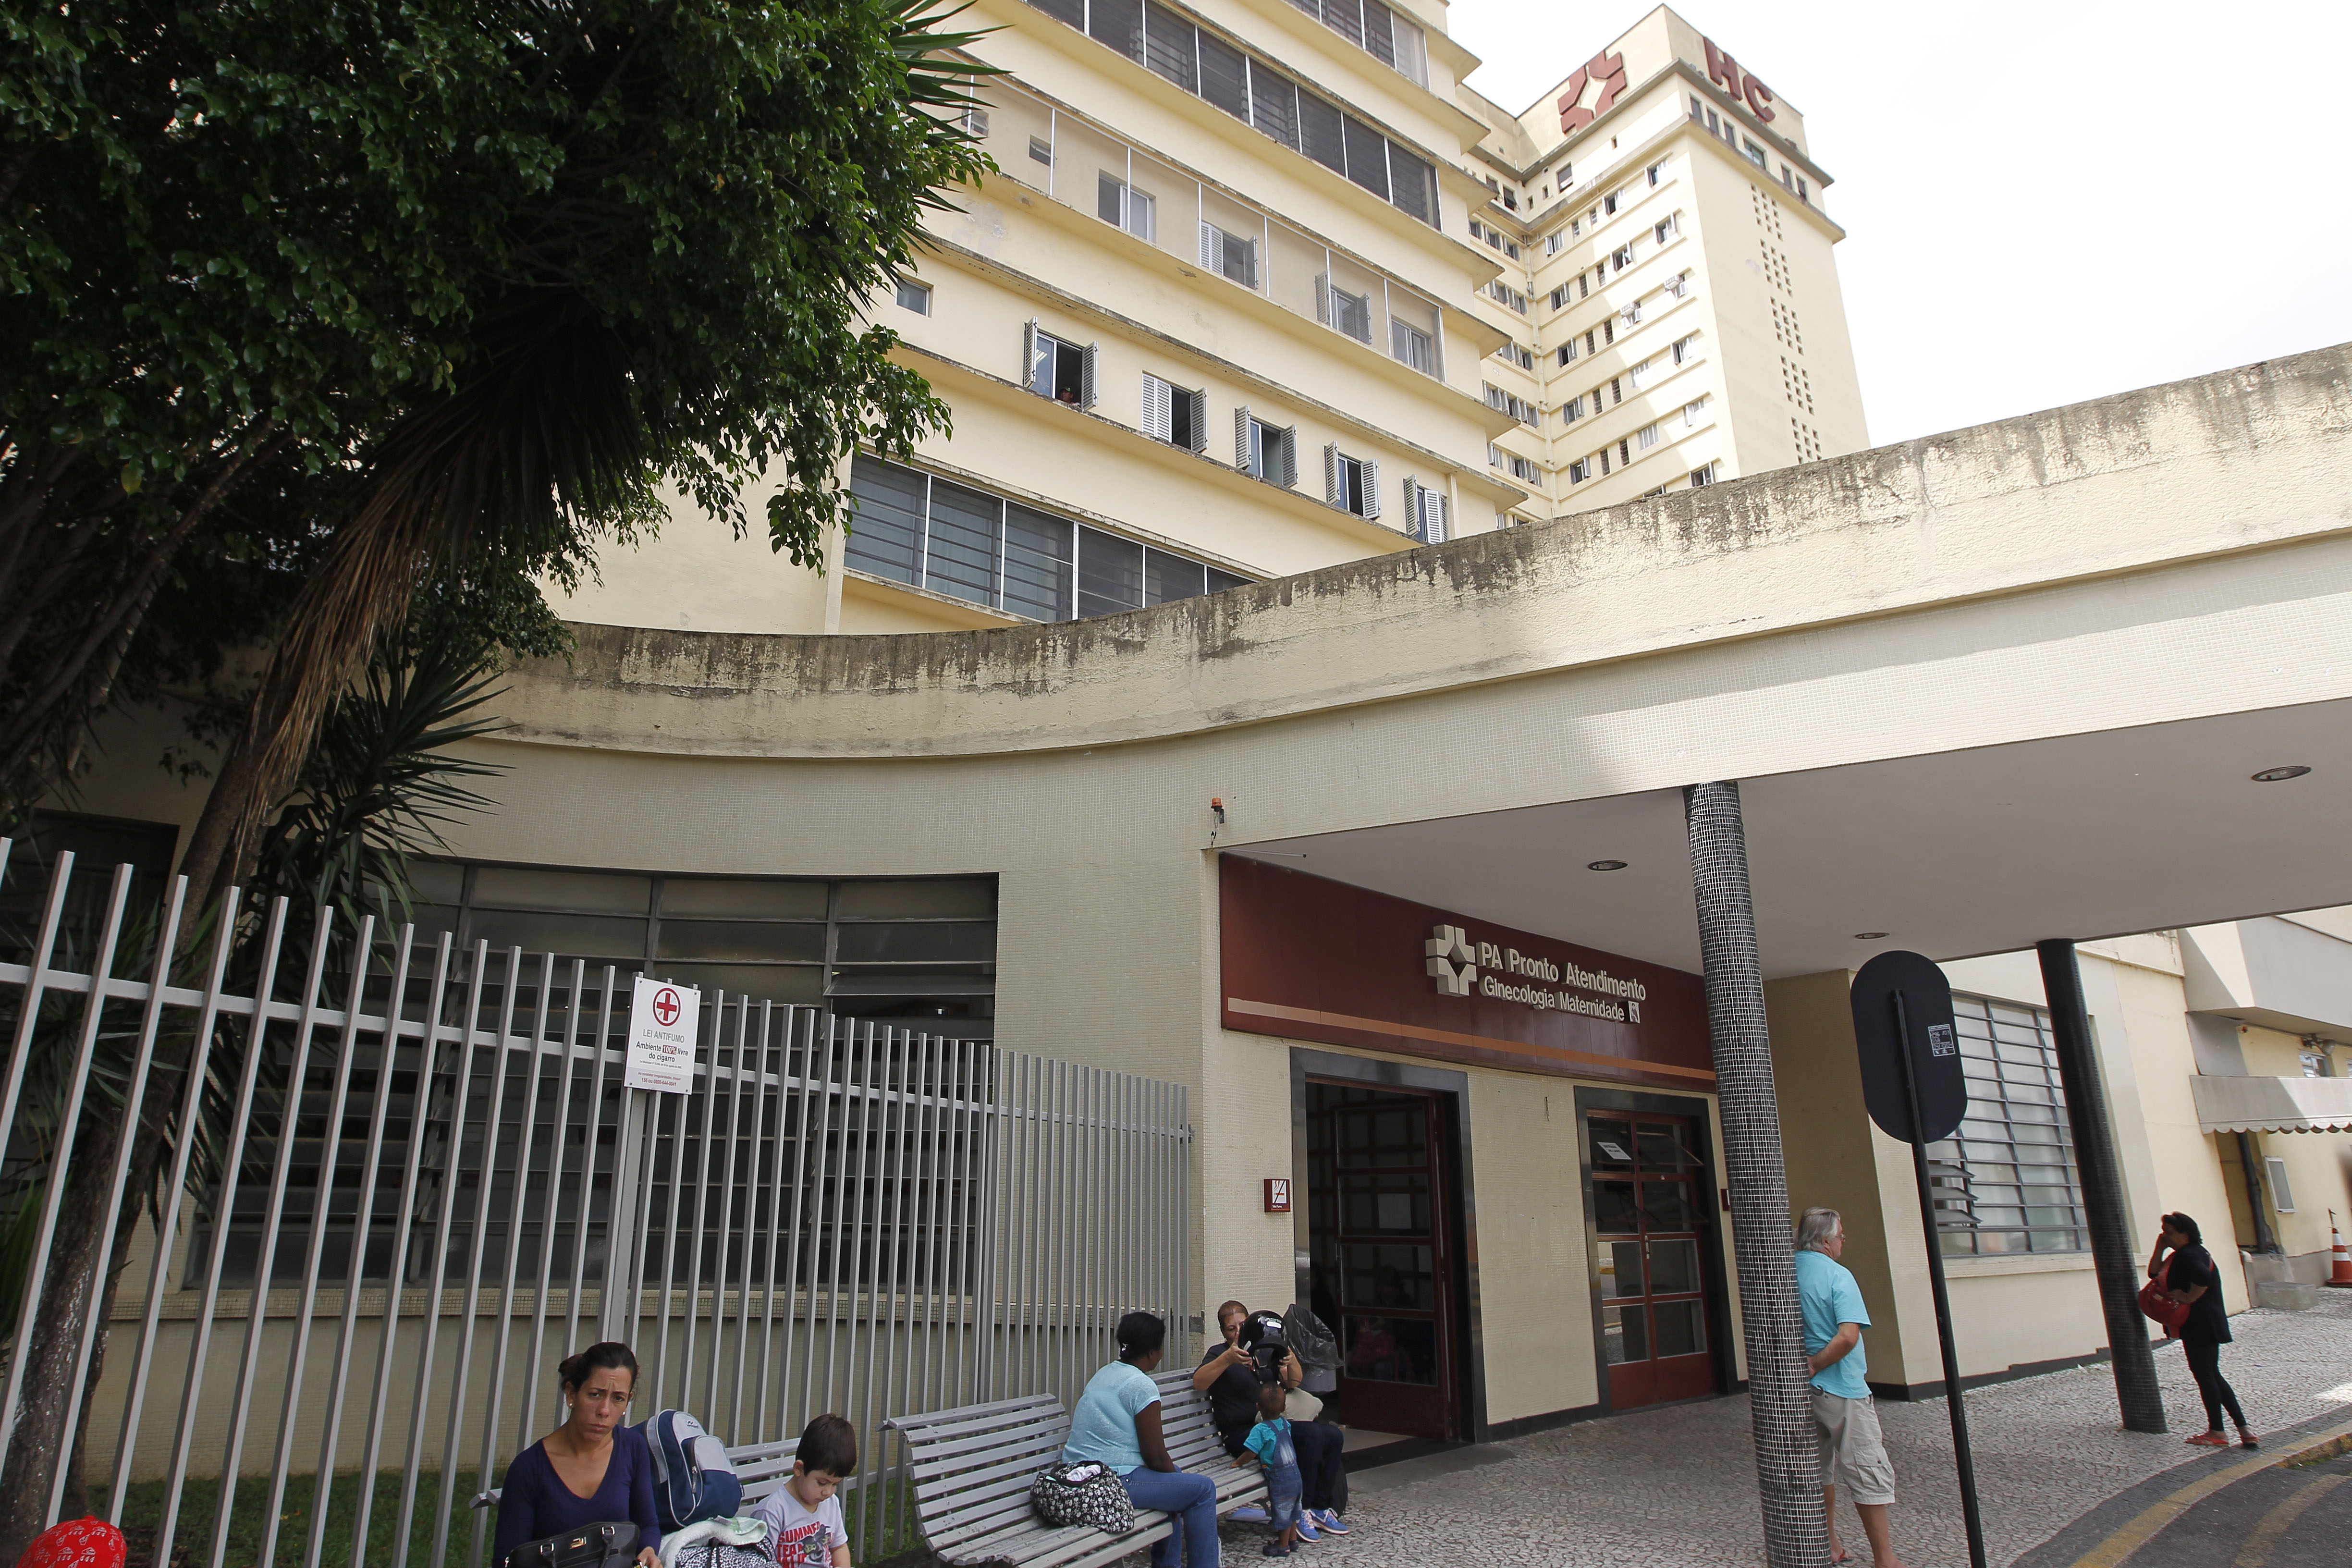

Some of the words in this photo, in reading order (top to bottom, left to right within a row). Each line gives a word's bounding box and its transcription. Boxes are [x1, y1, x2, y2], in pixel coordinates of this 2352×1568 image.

[1703, 37, 1776, 122] HC
[1478, 942, 1503, 969] PA
[1507, 948, 1559, 982] Pronto
[1565, 962, 1646, 1001] Atendimento
[1482, 976, 1556, 1009] Ginecologia
[1558, 992, 1625, 1021] Maternidade
[636, 1041, 662, 1051] Ambiente
[663, 1045, 676, 1054] 100%
[677, 1048, 688, 1056] livre
[643, 1029, 653, 1038] LEI
[654, 1031, 685, 1043] ANTIFUMO
[657, 1054, 675, 1062] cigarro
